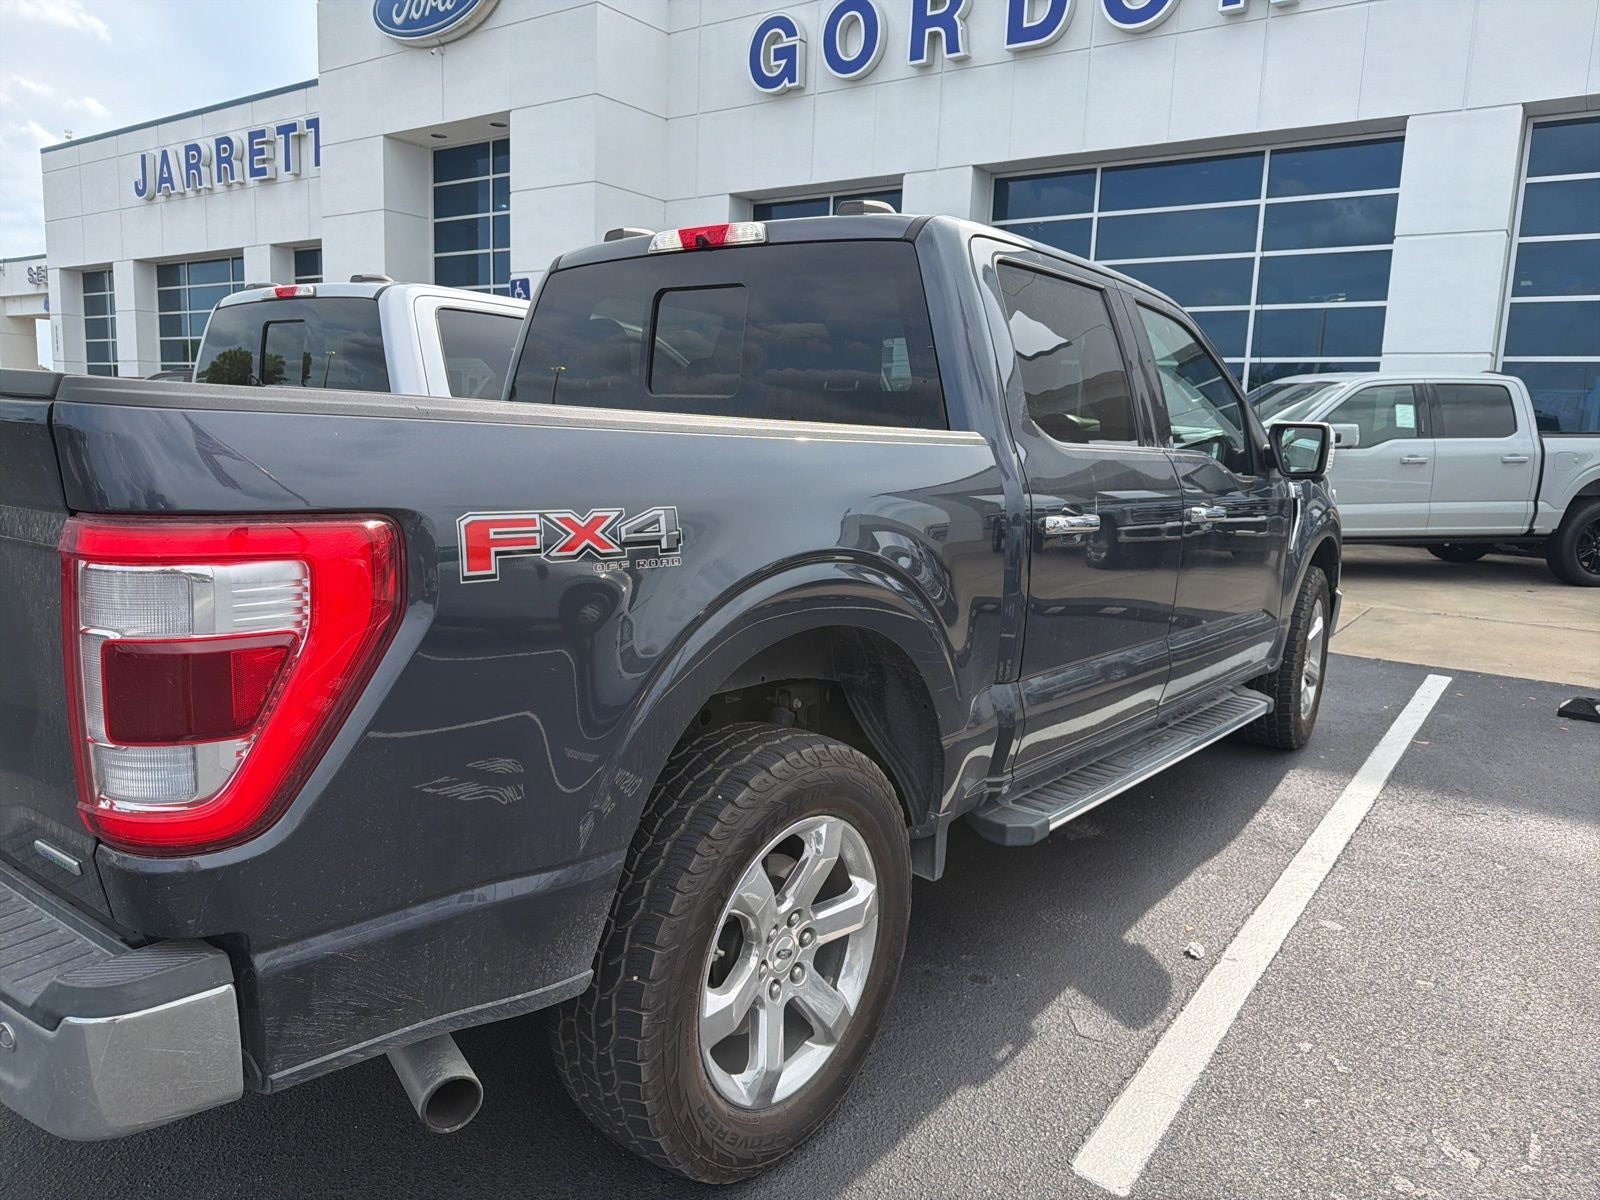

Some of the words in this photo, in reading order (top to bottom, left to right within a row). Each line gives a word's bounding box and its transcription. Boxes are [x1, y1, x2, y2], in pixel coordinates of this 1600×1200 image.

[134, 116, 320, 200] JARRETT
[455, 506, 683, 584] FX4
[592, 560, 630, 573] OFF
[635, 557, 682, 570] ROAD
